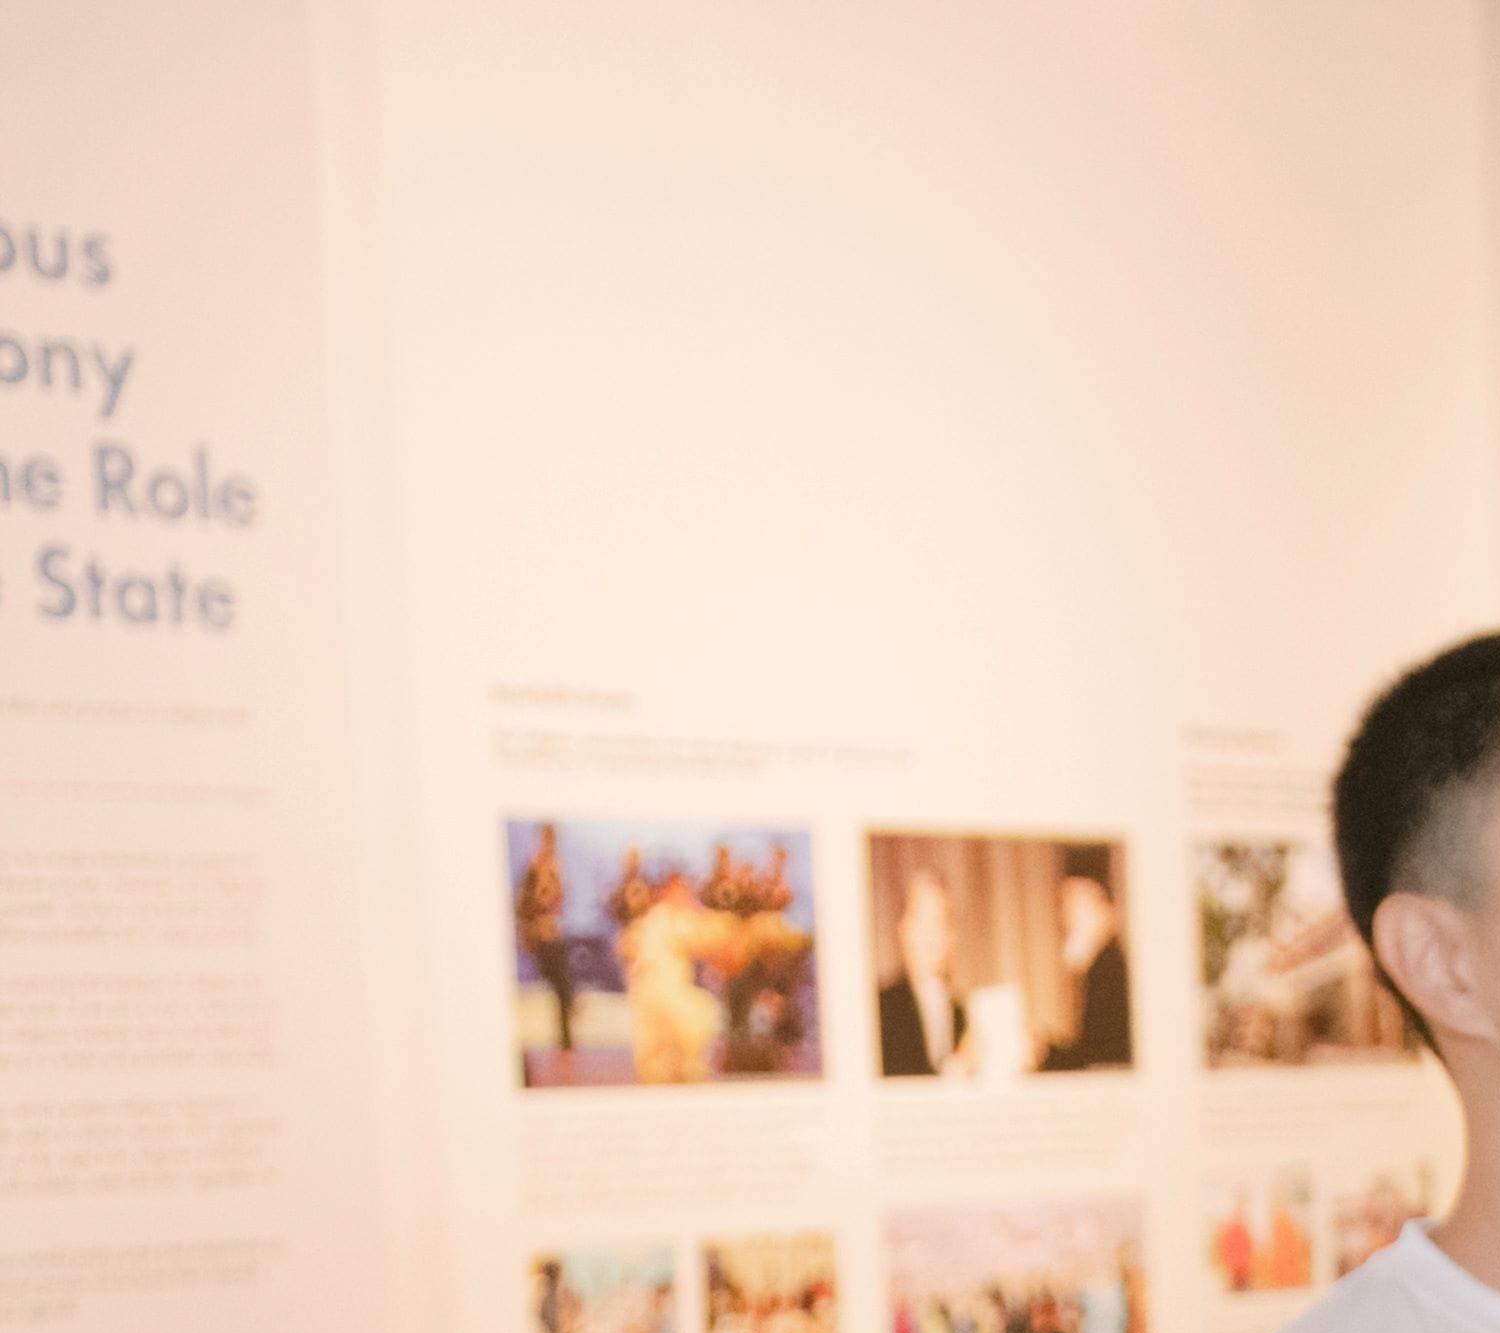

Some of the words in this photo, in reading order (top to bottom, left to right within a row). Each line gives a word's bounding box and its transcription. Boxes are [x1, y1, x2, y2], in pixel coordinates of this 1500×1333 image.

[0, 453, 62, 510] e
[92, 441, 257, 528] Role
[36, 541, 236, 633] State
